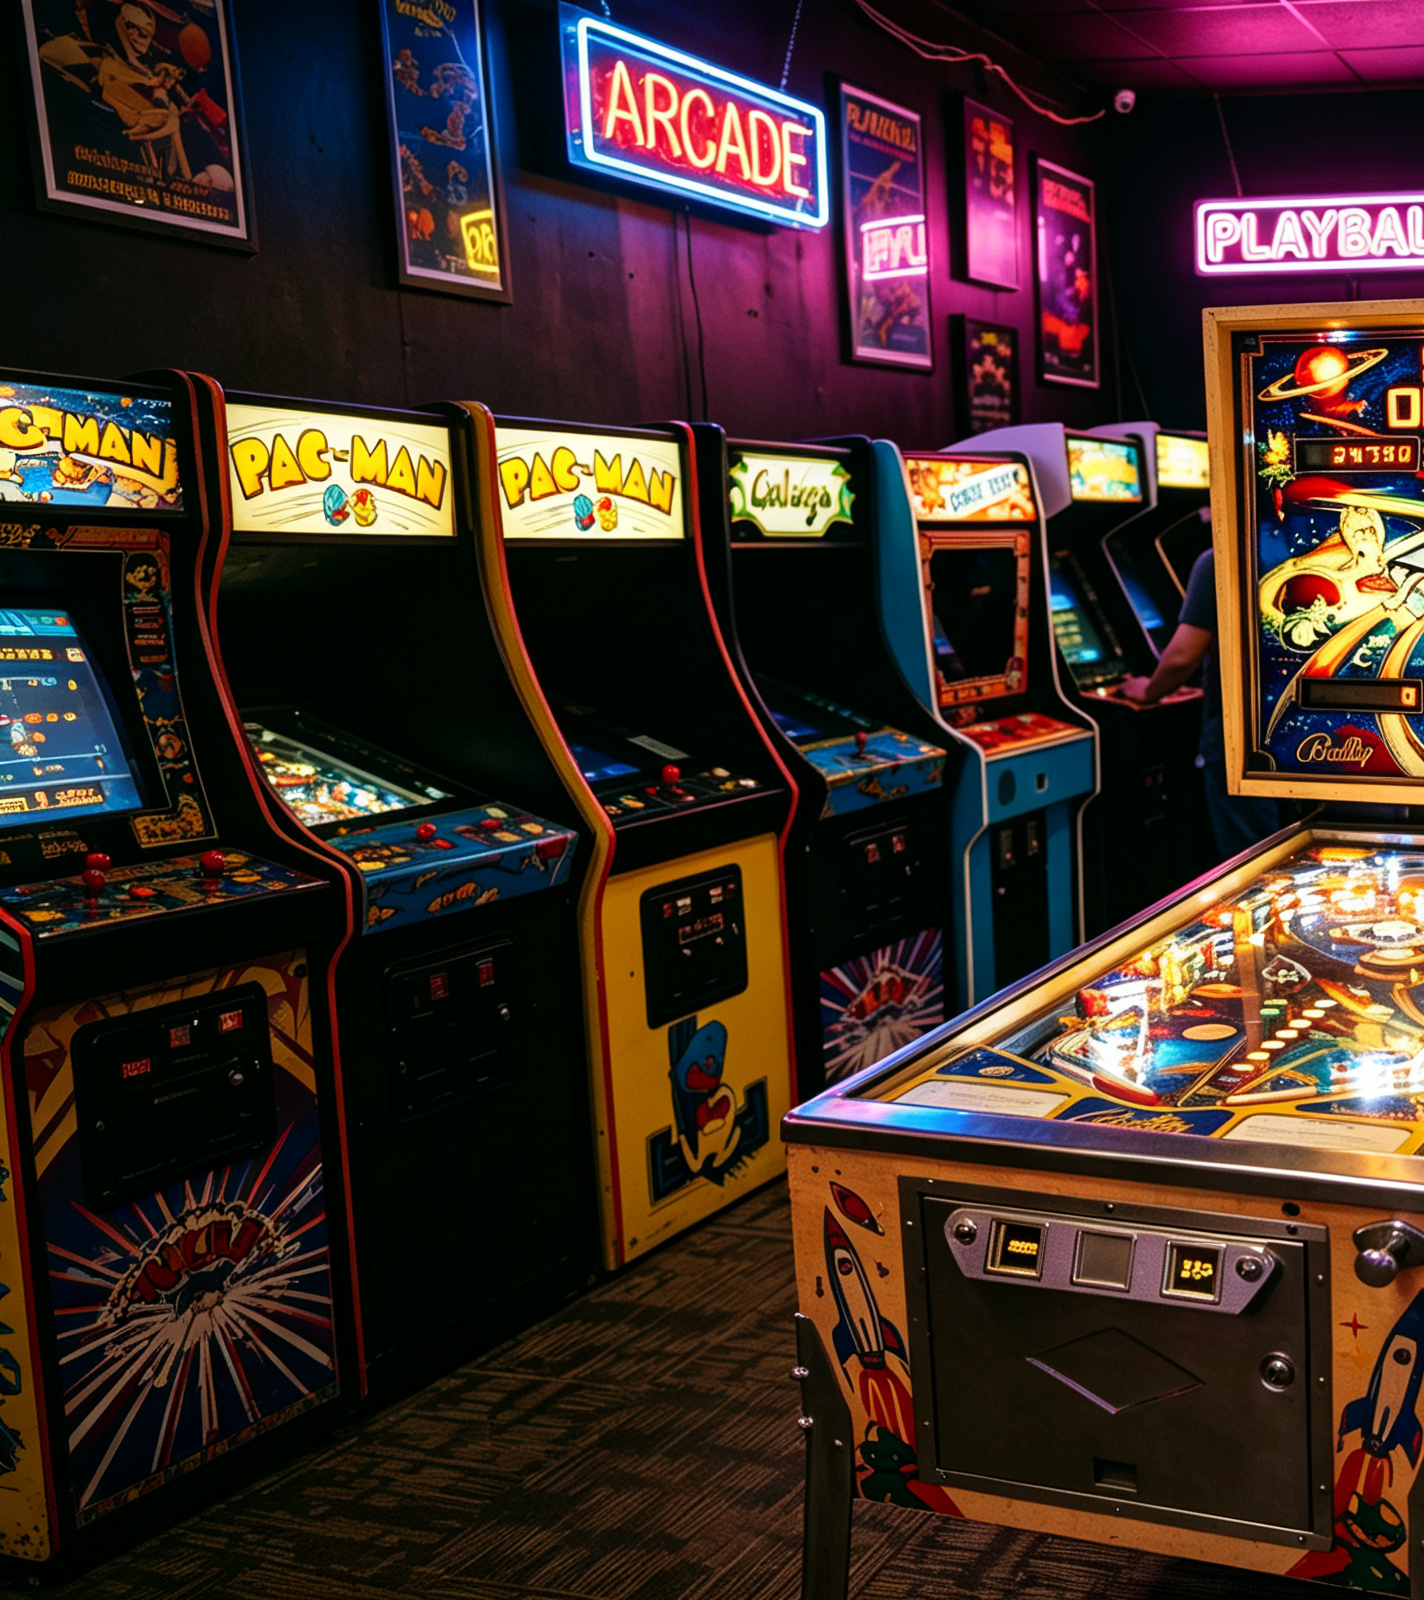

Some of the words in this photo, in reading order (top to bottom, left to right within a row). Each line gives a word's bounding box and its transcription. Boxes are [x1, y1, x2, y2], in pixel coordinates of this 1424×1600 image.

[604, 60, 814, 199] ARCADE
[230, 428, 447, 511] PAC-MAN
[498, 446, 677, 516] PAC-MAN
